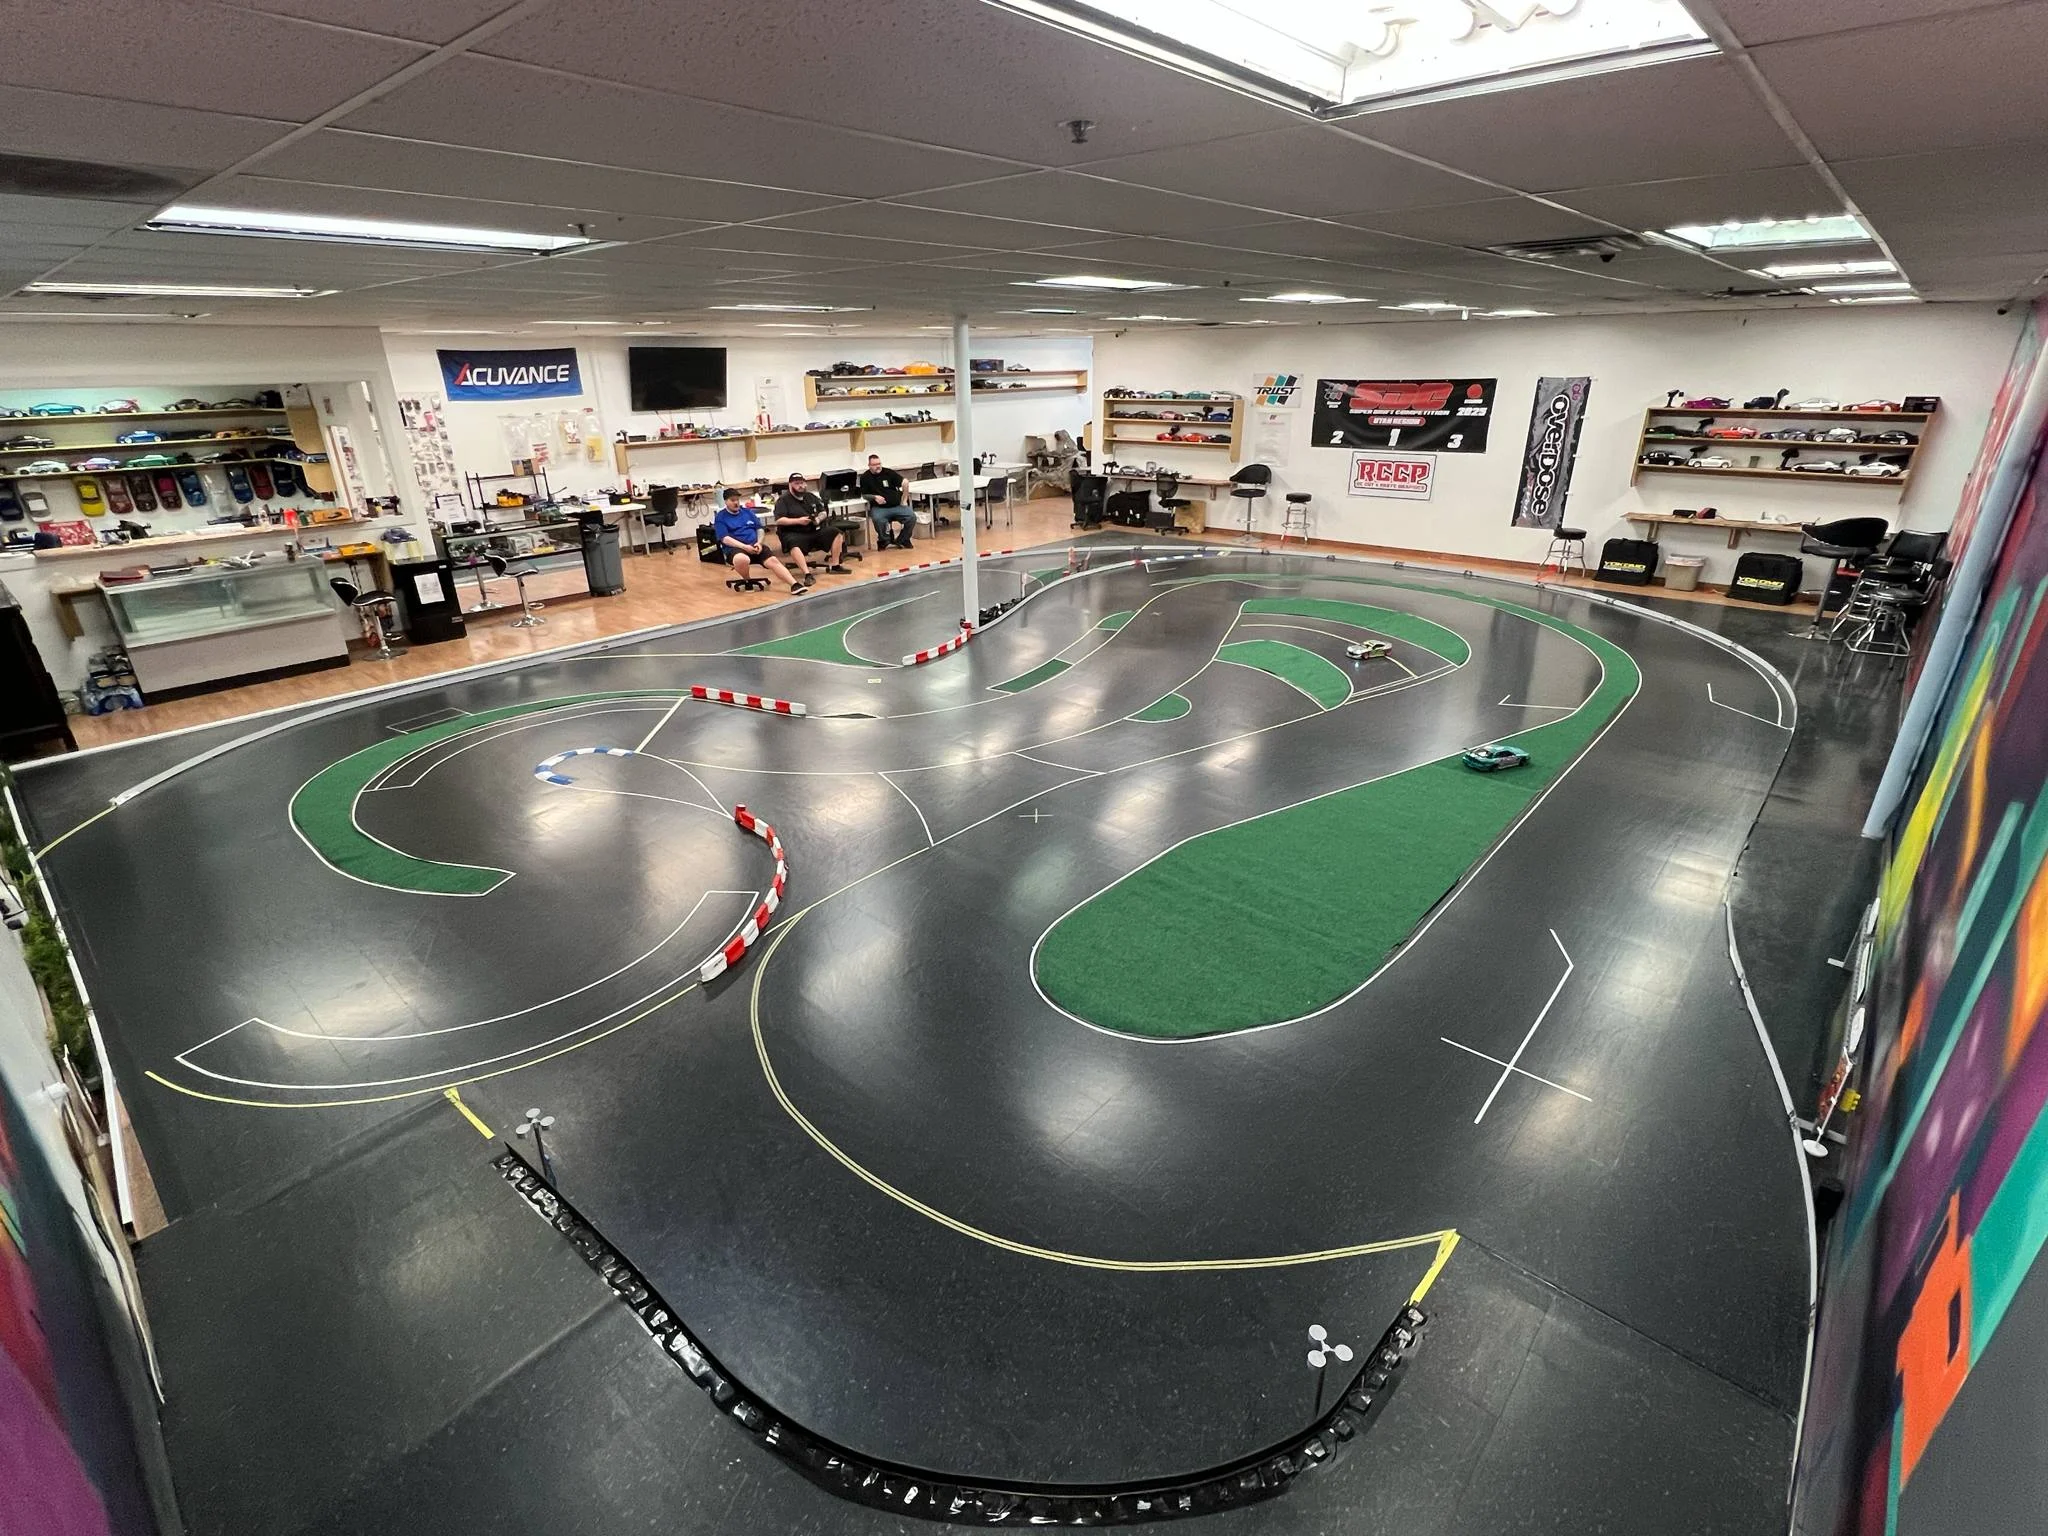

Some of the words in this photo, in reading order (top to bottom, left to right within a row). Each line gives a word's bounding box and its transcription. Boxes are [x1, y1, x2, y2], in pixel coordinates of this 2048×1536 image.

[454, 363, 569, 385] ACUVANCE
[1254, 386, 1300, 395] TRUST
[1349, 383, 1454, 409] SDC
[1330, 430, 1344, 444] 2
[1388, 428, 1400, 446] 1
[1447, 434, 1463, 448] 3
[1359, 461, 1428, 483] RCCP
